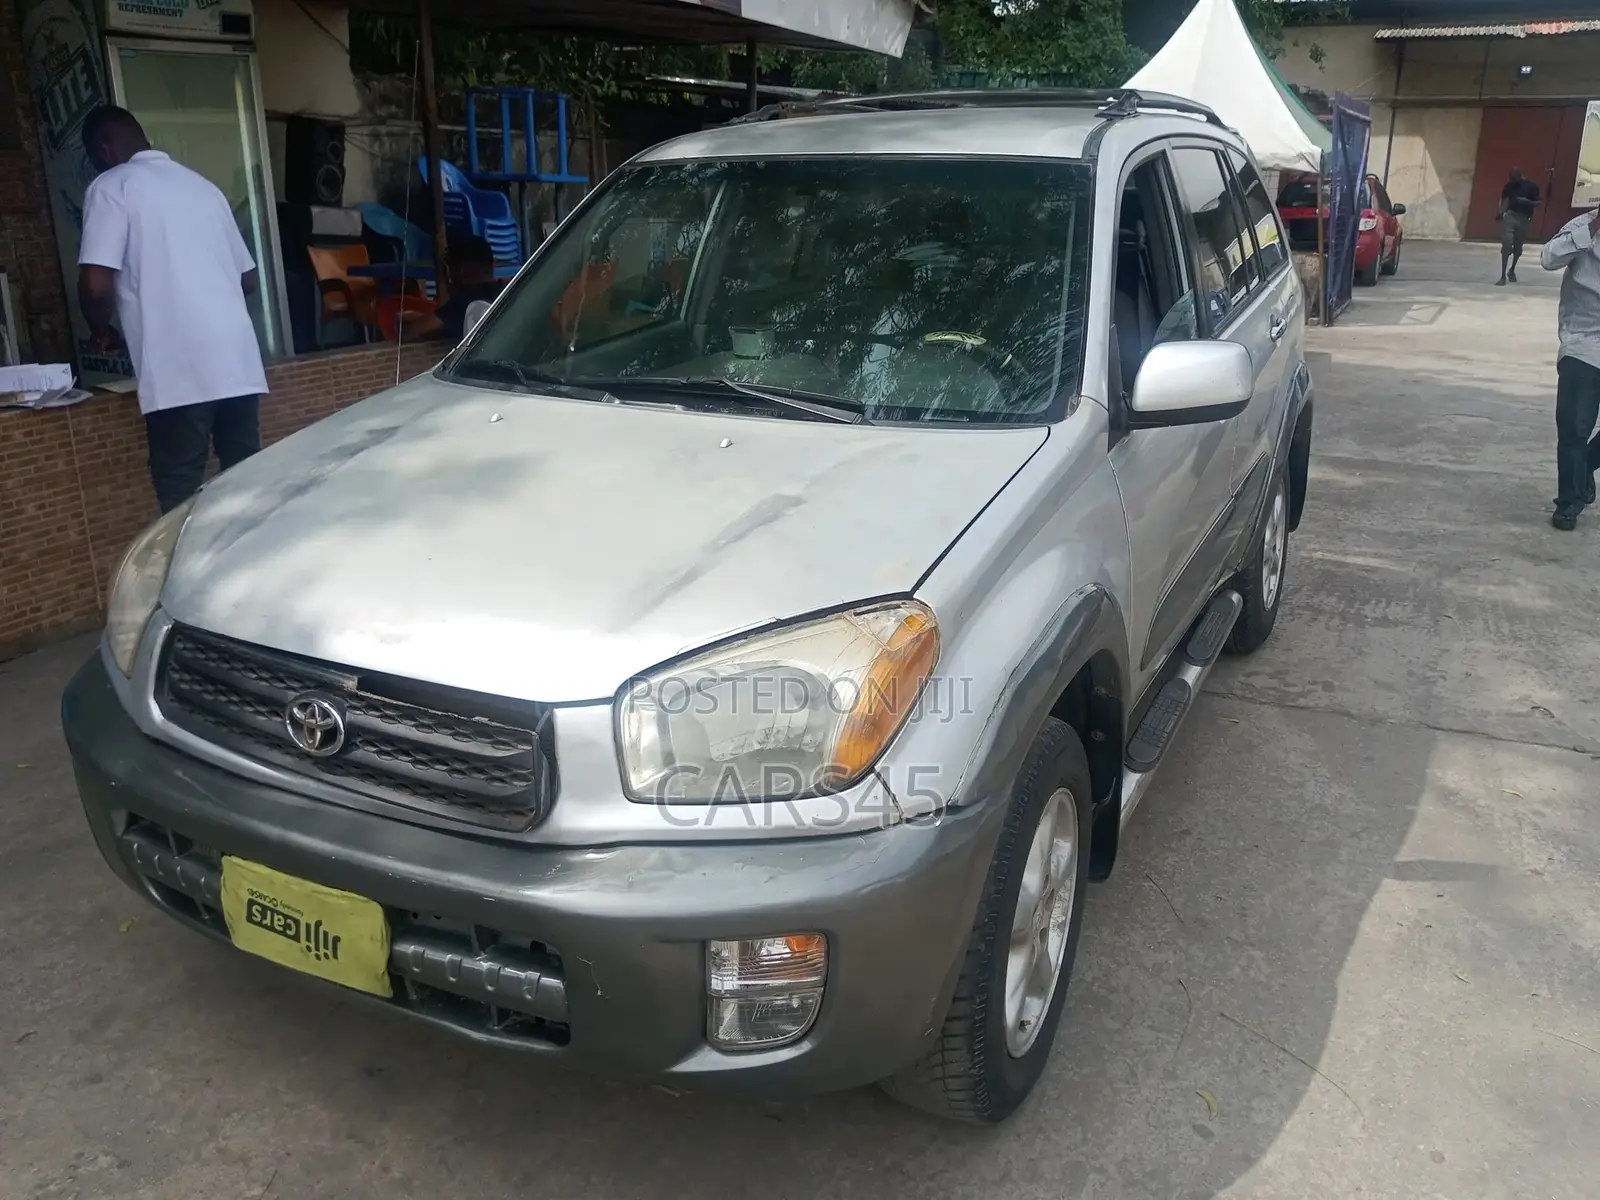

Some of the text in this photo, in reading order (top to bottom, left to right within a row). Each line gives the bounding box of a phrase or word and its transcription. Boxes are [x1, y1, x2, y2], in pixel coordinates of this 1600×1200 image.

[118, 3, 184, 19] REFRESHMENT
[46, 58, 93, 133] LITE
[252, 904, 296, 935] cars
